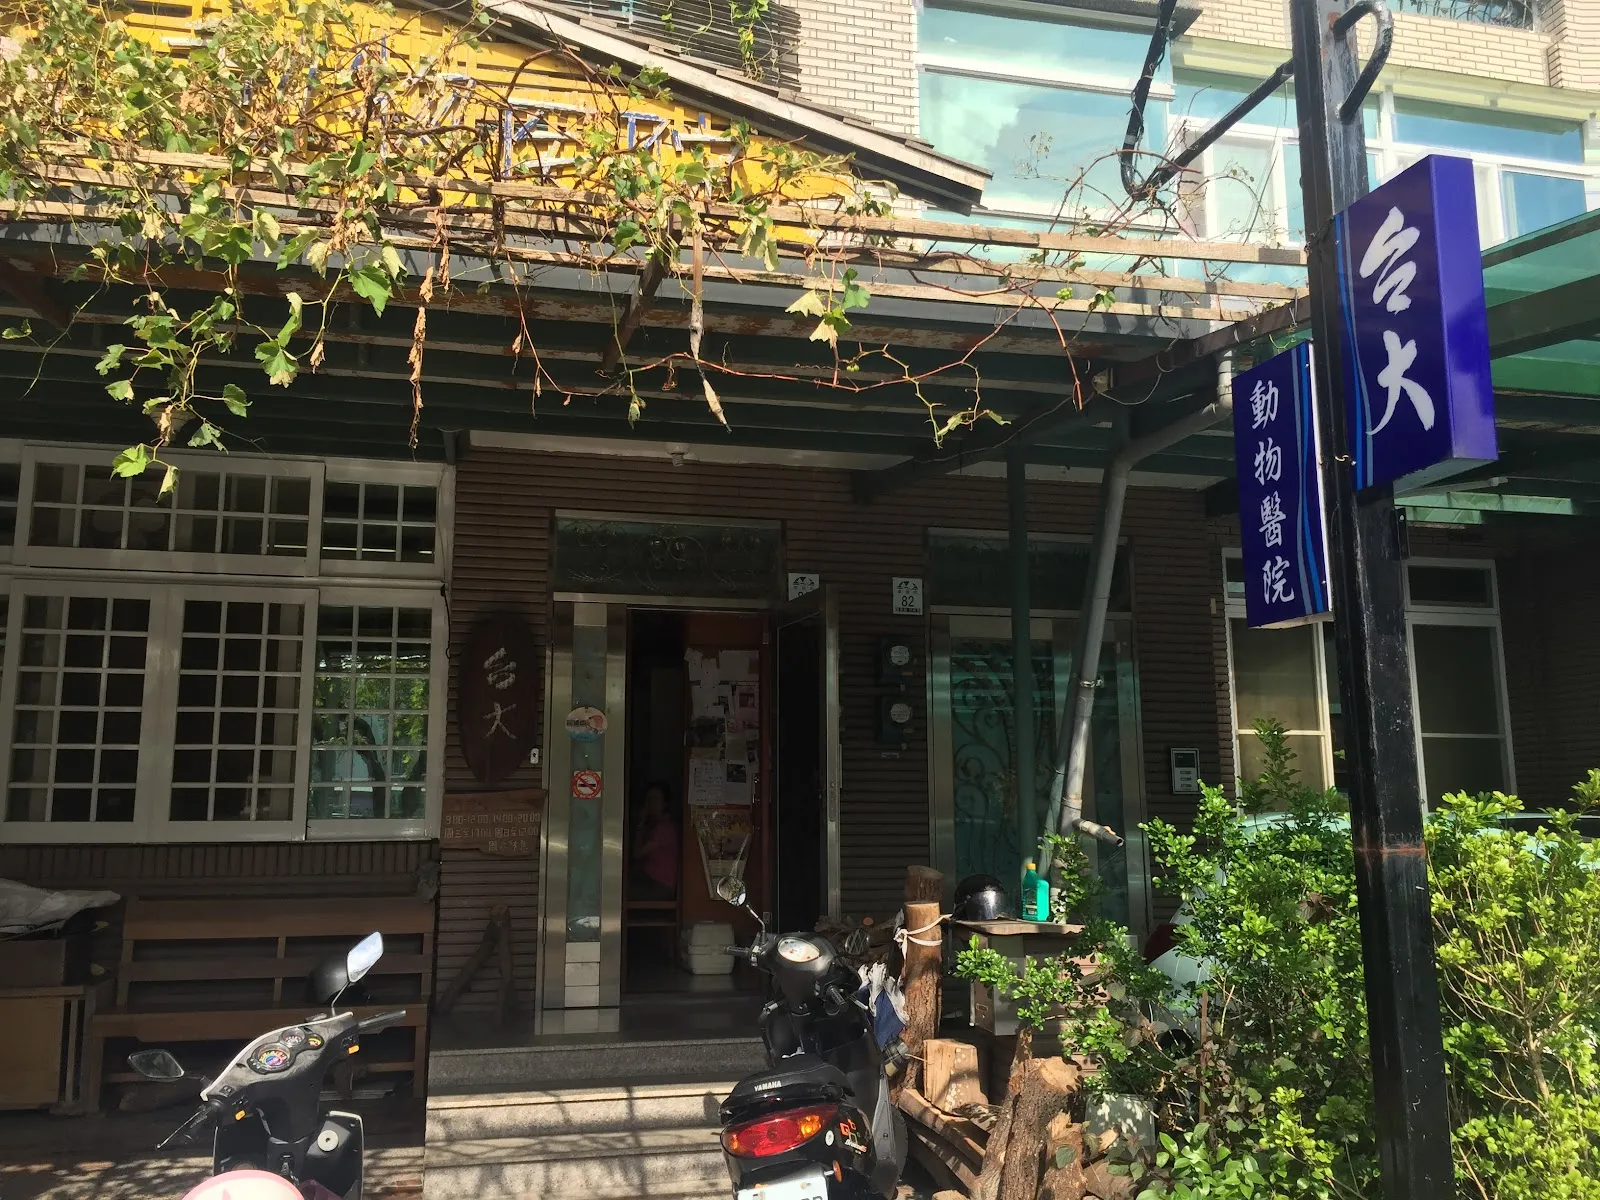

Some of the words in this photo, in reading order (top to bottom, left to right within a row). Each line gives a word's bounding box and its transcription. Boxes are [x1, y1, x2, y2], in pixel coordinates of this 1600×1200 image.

[1359, 205, 1436, 436] 台大
[1249, 379, 1295, 605] 動物醫院
[902, 595, 915, 608] 82
[482, 646, 517, 740] 台大
[754, 1080, 782, 1092] YAMAHA
